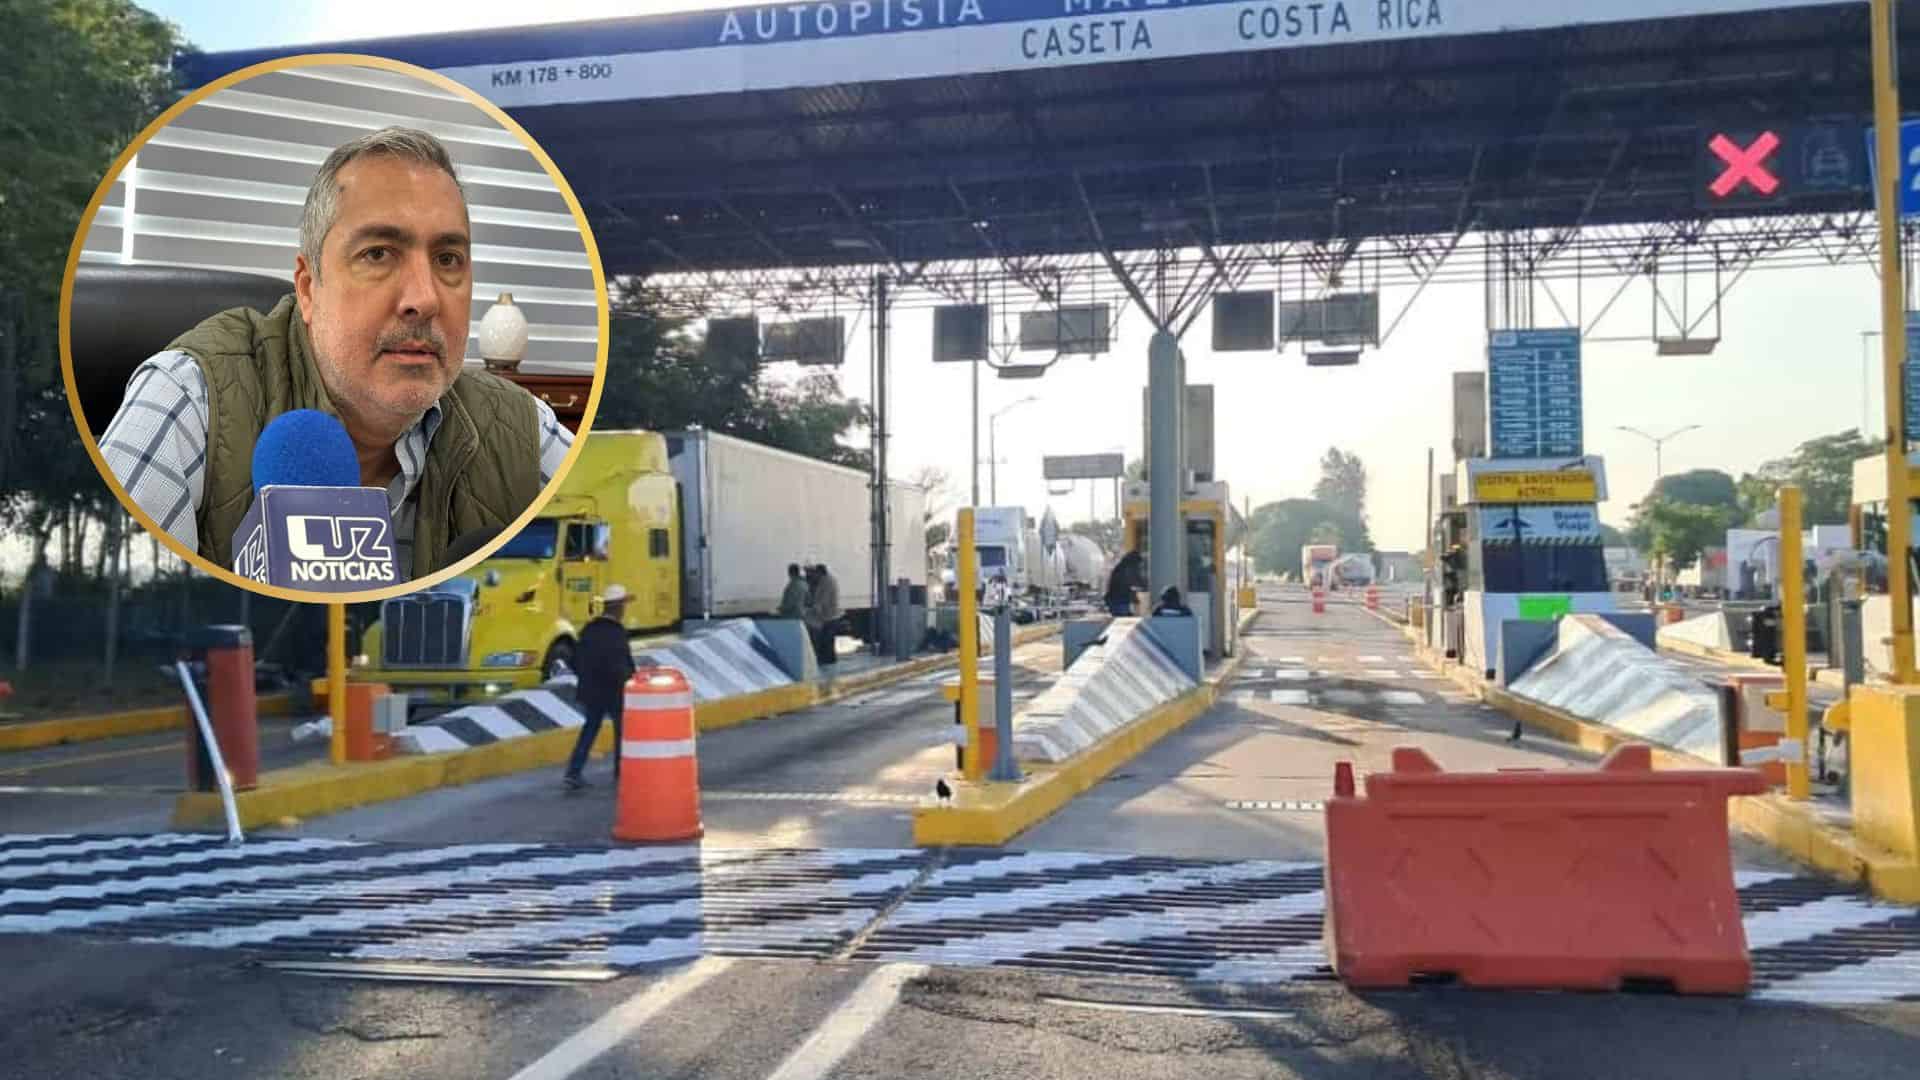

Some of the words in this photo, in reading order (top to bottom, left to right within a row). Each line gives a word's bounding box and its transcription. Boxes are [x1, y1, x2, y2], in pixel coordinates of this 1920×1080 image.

[719, 0, 985, 42] AUTOPISTA
[1021, 19, 1153, 60] CASETA
[1238, 2, 1352, 40] COSTA
[1377, 0, 1441, 30] RICA
[491, 69, 522, 88] KM
[528, 66, 557, 84] 178
[578, 63, 612, 80] 800
[286, 515, 393, 561] LUZ
[290, 561, 395, 582] NOTICIAS
